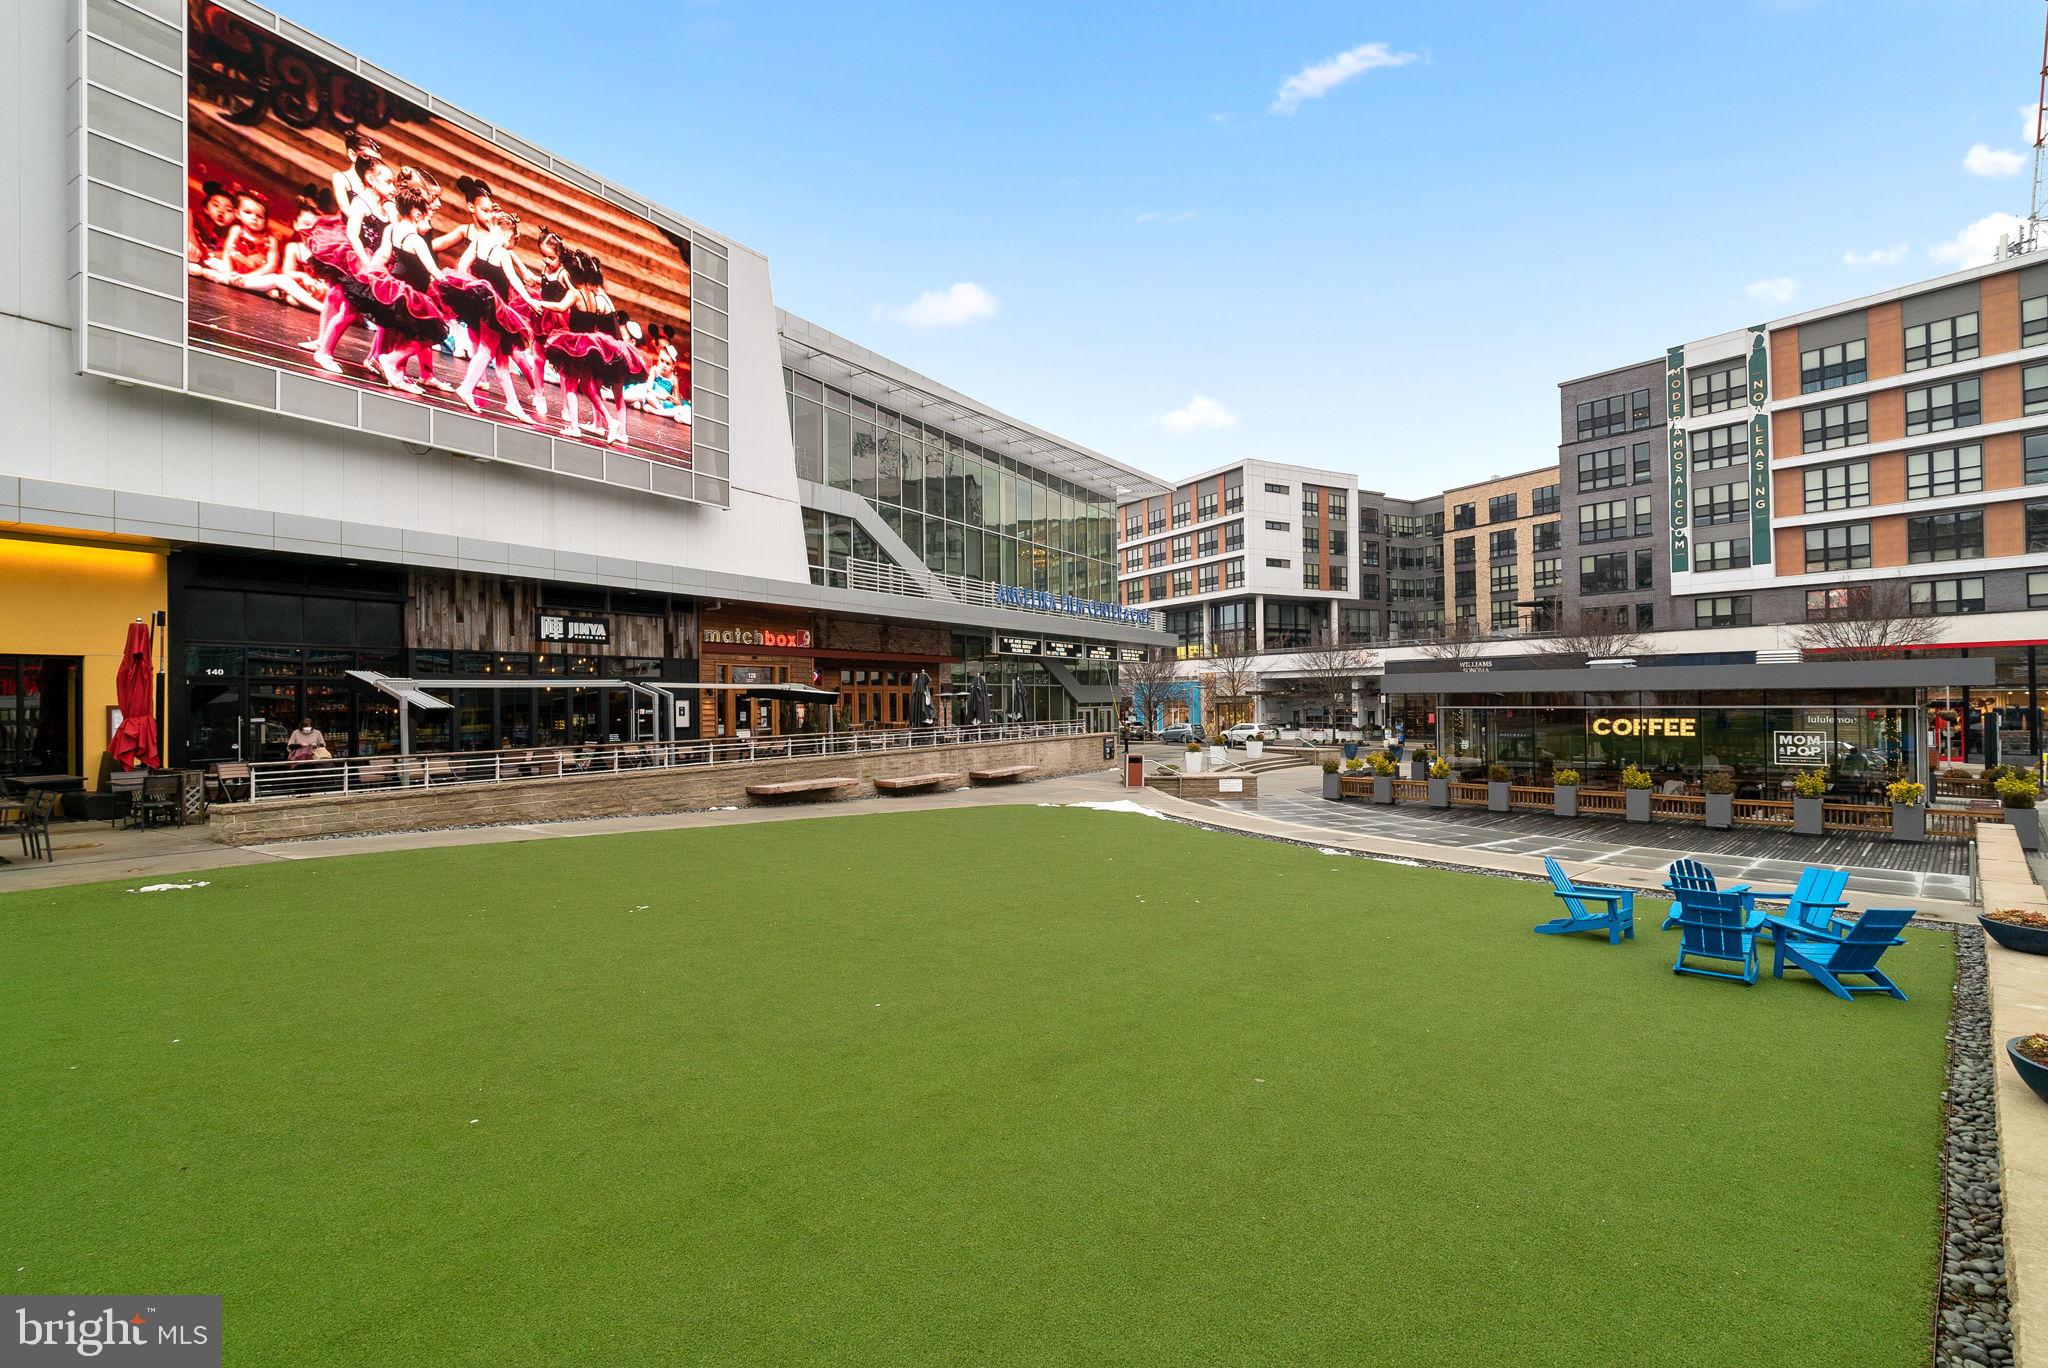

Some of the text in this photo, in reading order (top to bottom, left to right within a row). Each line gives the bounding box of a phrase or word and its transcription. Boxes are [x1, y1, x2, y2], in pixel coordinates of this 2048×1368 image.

[1754, 422, 1767, 510] LEASING
[568, 622, 606, 638] JINYA
[704, 628, 796, 647] matchbox
[1593, 718, 1696, 736] COFFEE
[1779, 735, 1820, 745] MOM
[1786, 746, 1821, 756] POP
